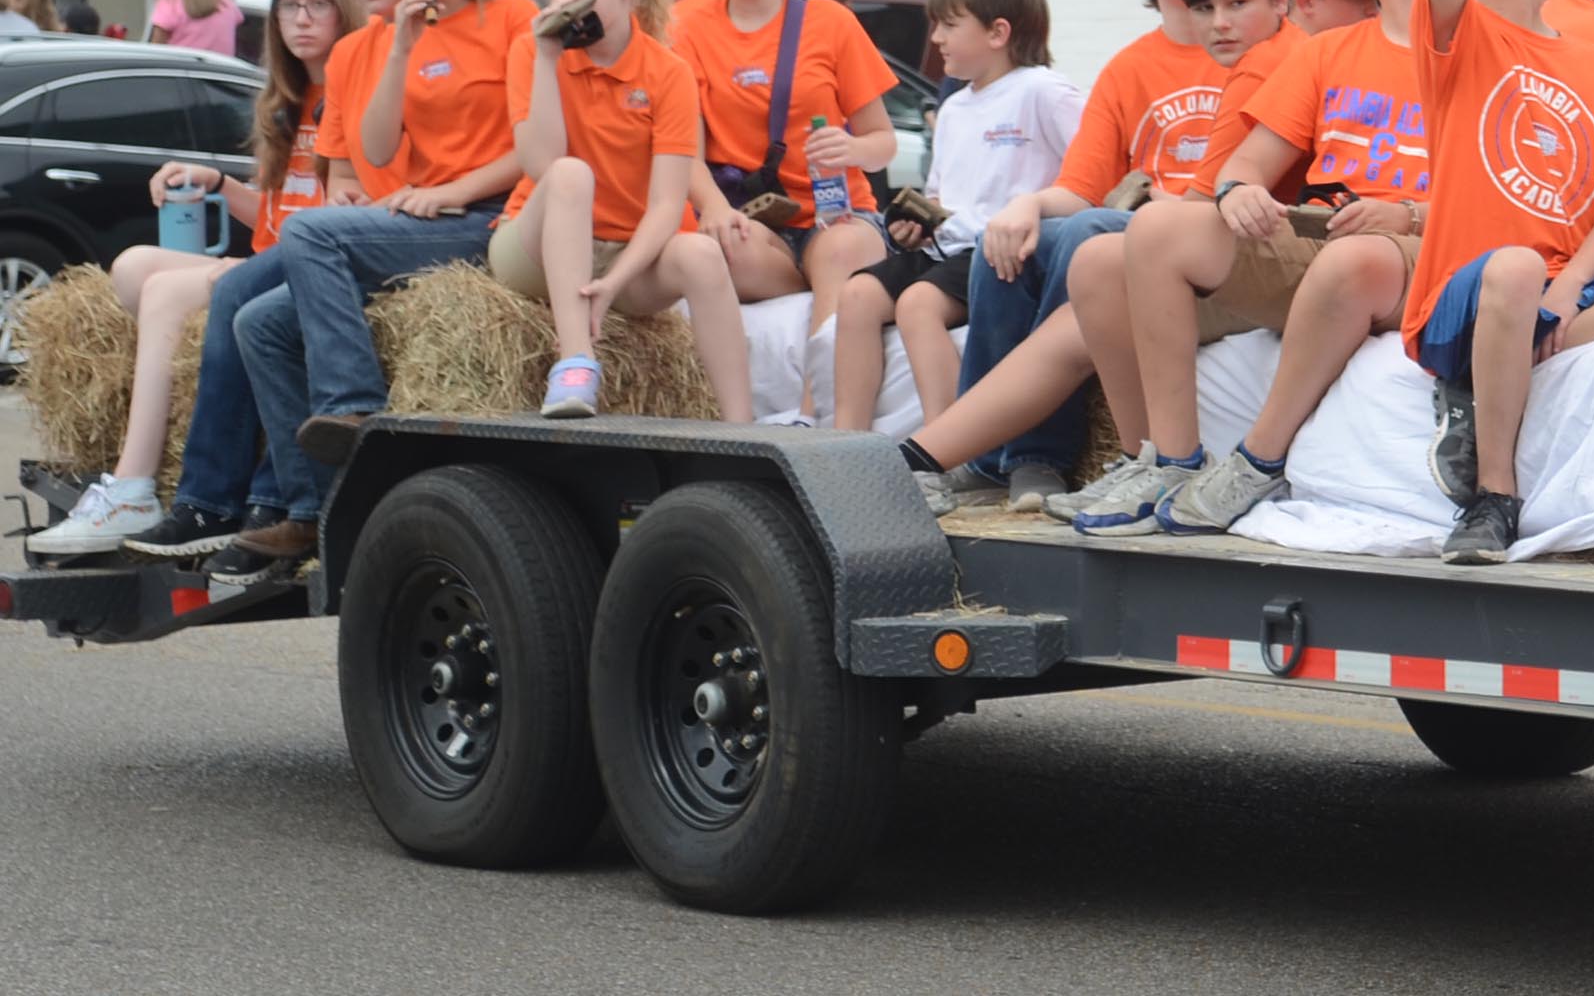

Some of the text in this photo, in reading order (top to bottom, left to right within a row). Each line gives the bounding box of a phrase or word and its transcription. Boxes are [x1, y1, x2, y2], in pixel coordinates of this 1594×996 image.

[1153, 93, 1221, 128] COLUM
[1519, 73, 1581, 124] LUMBIA
[1500, 166, 1566, 215] ACADE
